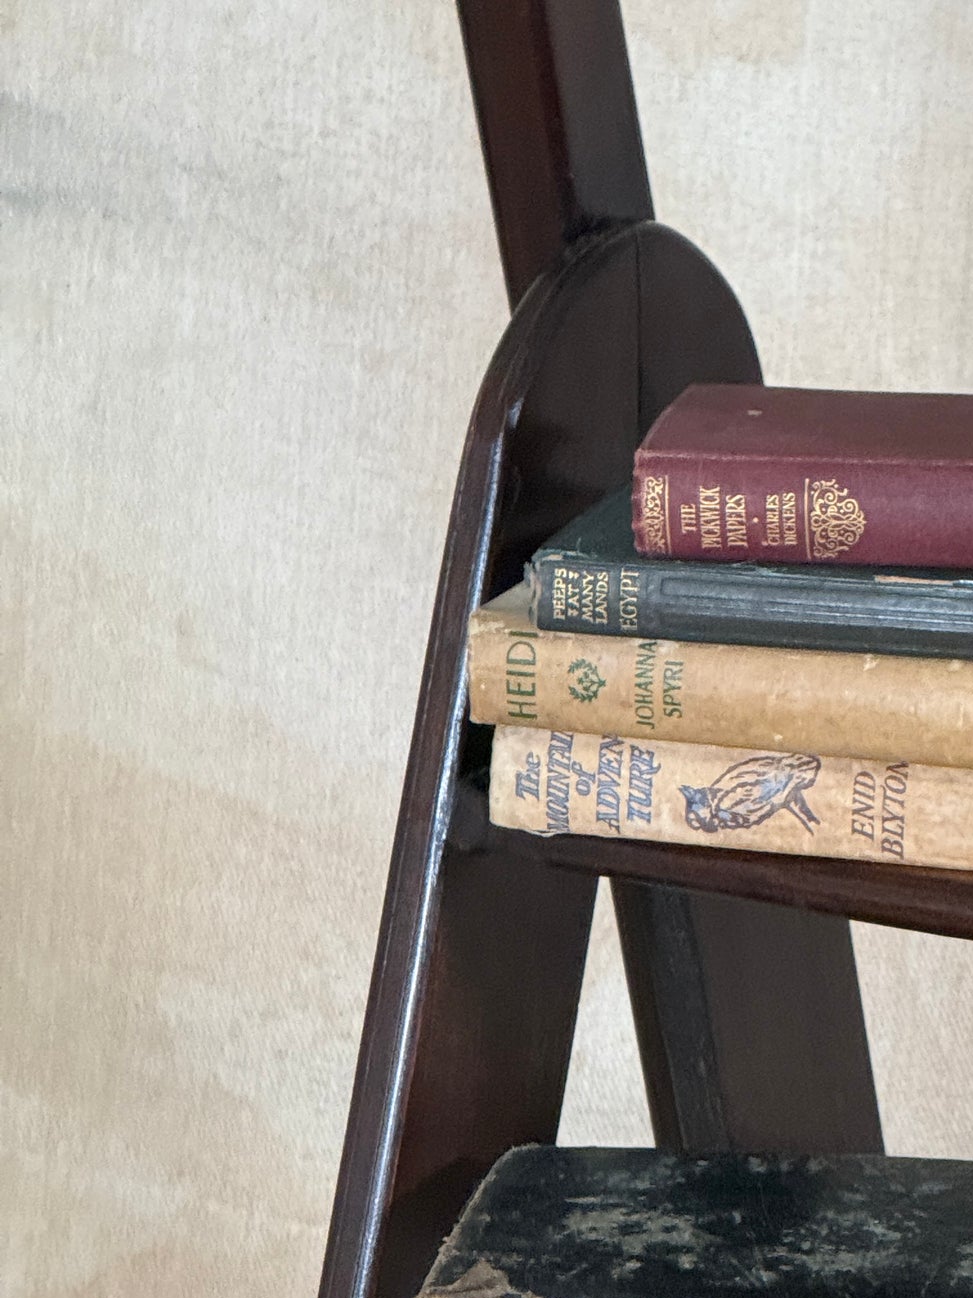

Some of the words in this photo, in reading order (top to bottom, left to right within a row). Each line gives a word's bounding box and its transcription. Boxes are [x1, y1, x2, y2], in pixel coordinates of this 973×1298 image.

[680, 503, 697, 533] THE
[700, 484, 722, 549] PICKWICK
[725, 494, 748, 548] PAPERS
[765, 494, 781, 546] CHARLES
[782, 492, 797, 546] DICKENS
[553, 567, 567, 620] PEEPS
[567, 583, 580, 609] AT
[581, 570, 595, 624] MANY
[595, 571, 609, 625] LANDS
[619, 567, 640, 631] EGYPT
[506, 630, 539, 721] HEIDI
[634, 638, 659, 730] JOHANNA
[663, 659, 685, 719] SPYRI
[515, 751, 542, 801] The
[571, 760, 597, 797] of
[626, 743, 663, 824] TURE
[851, 769, 877, 842] ENID
[881, 760, 911, 861] BLYTON
